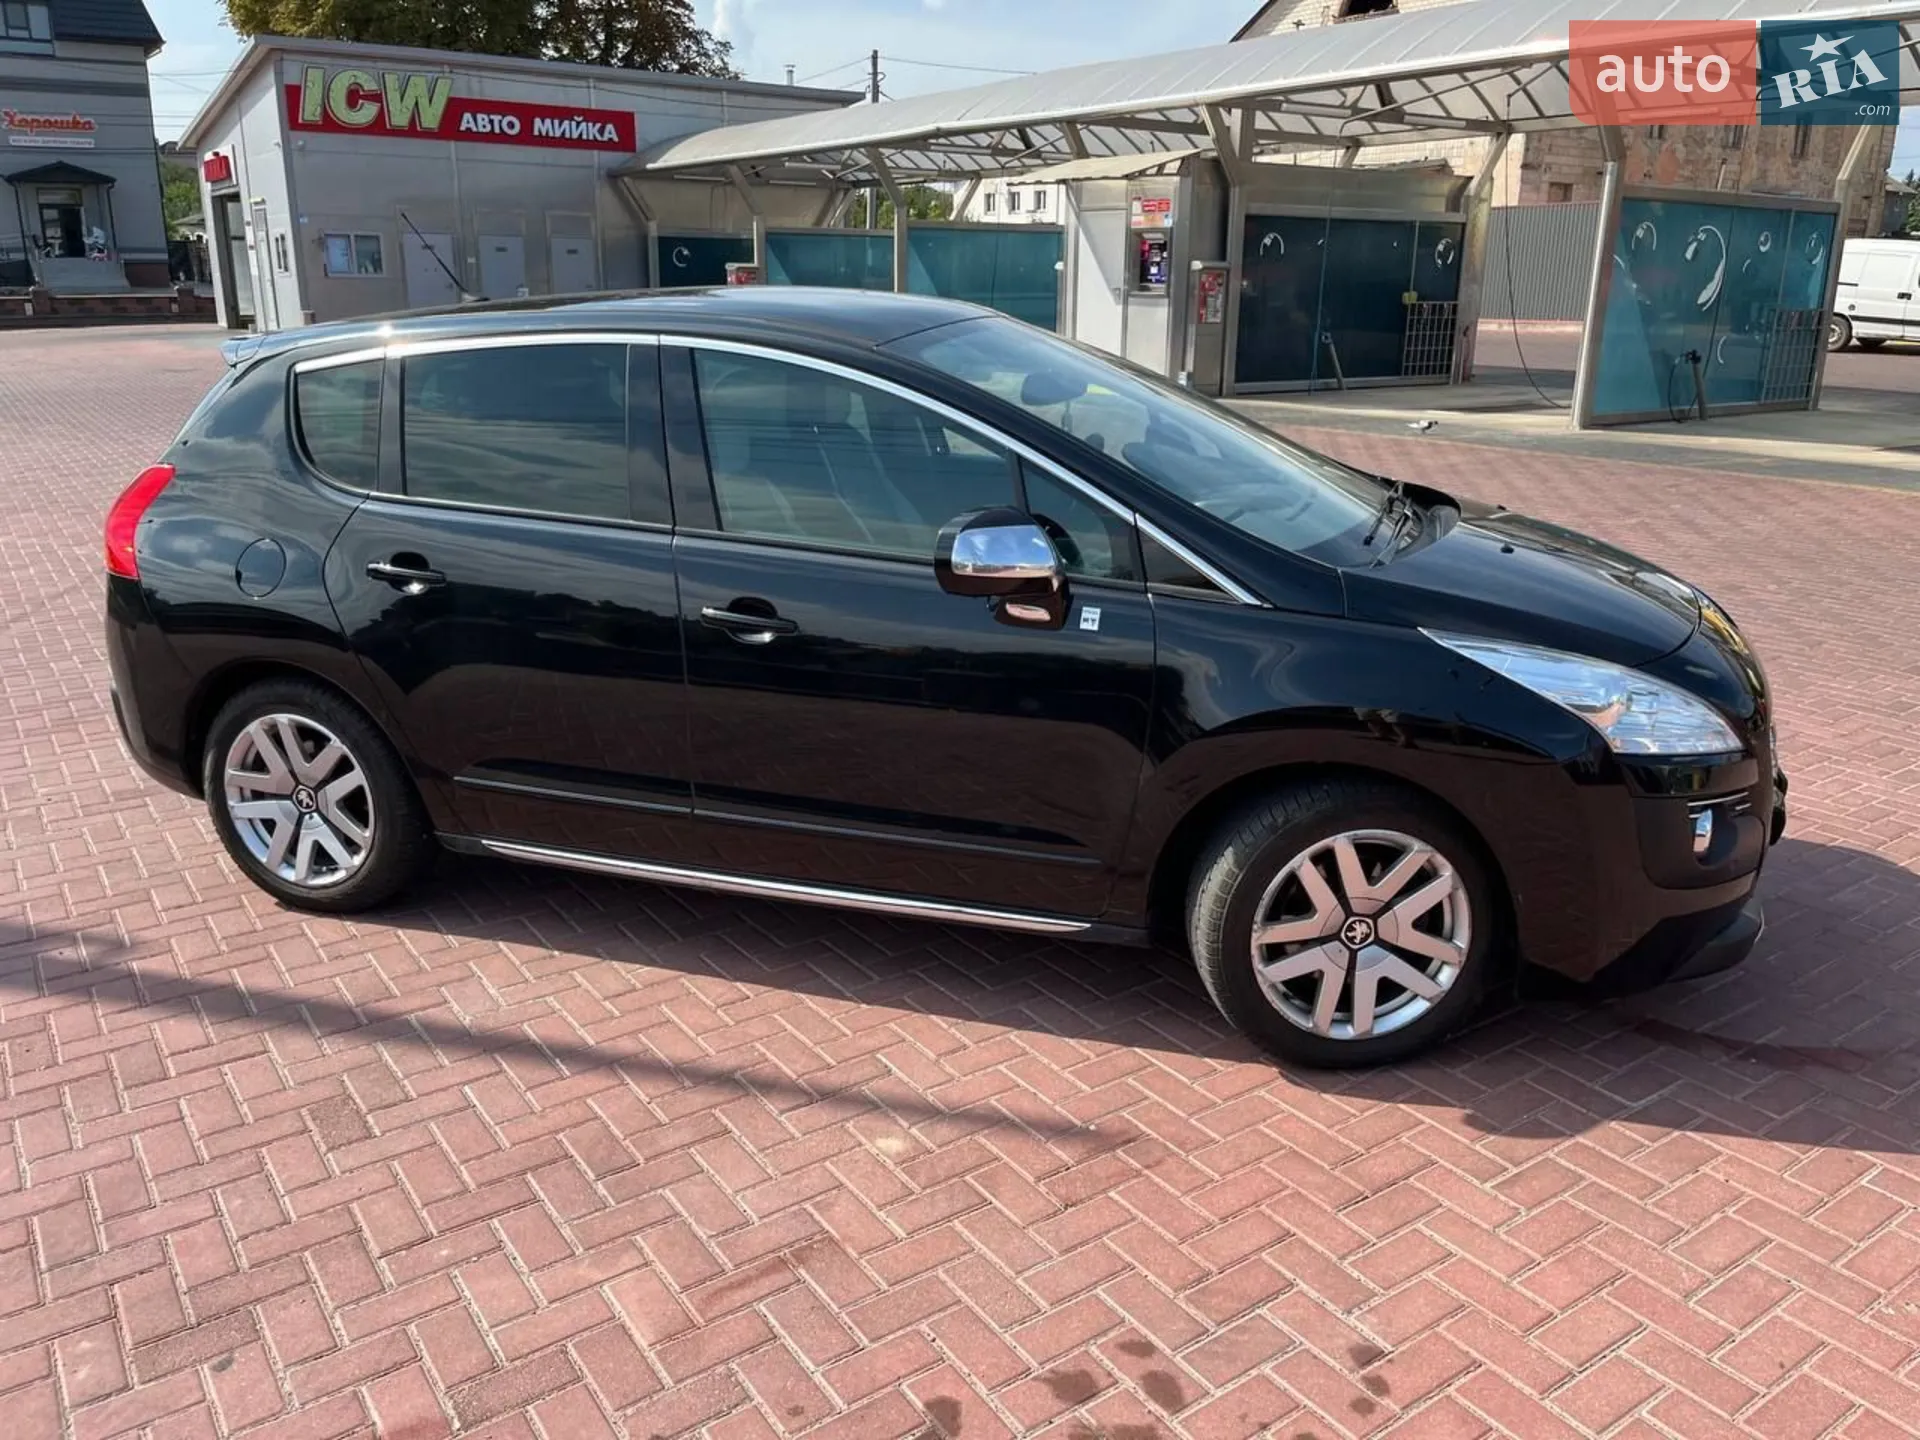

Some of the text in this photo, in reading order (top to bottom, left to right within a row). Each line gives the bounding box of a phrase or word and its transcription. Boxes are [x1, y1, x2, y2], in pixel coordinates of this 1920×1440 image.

[299, 64, 452, 132] ICW
[459, 112, 619, 142] АВТО МИЙКА
